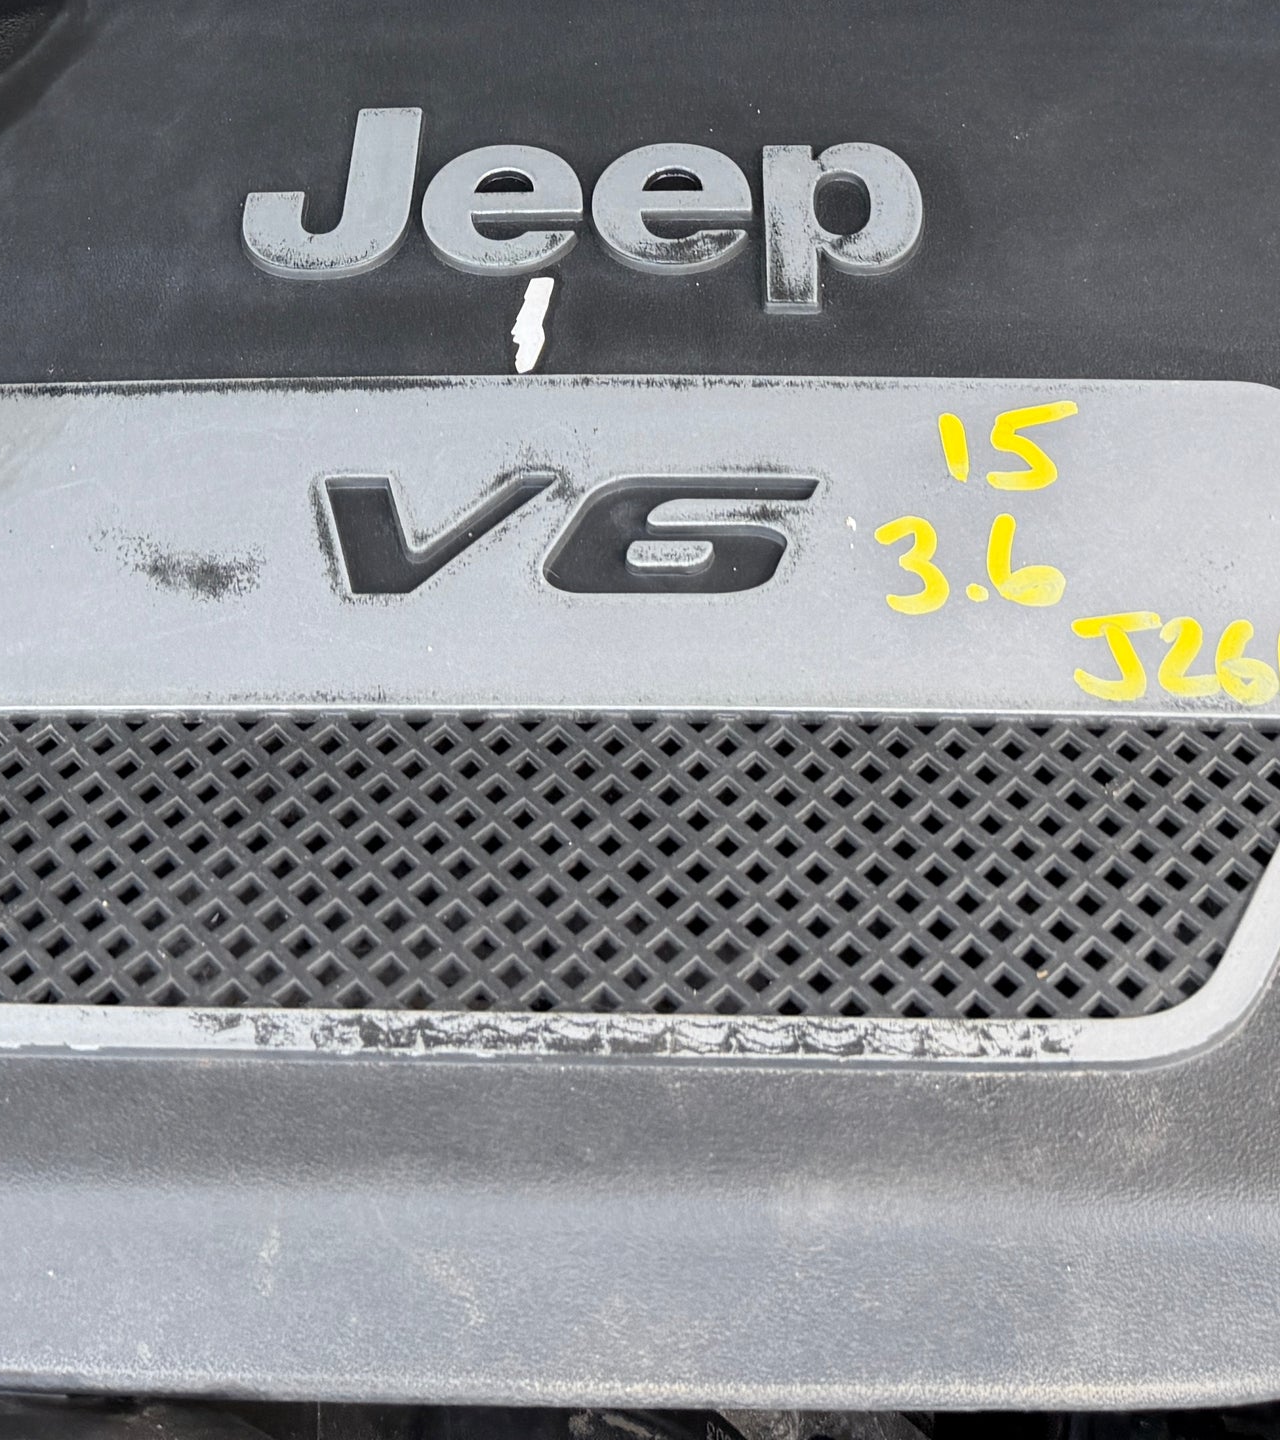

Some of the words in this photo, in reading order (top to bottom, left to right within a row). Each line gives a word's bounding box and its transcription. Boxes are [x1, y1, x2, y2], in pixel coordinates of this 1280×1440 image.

[242, 107, 924, 313] Jeep
[938, 400, 1079, 491] 15
[324, 473, 821, 595] V6
[874, 513, 1067, 615] 3.6
